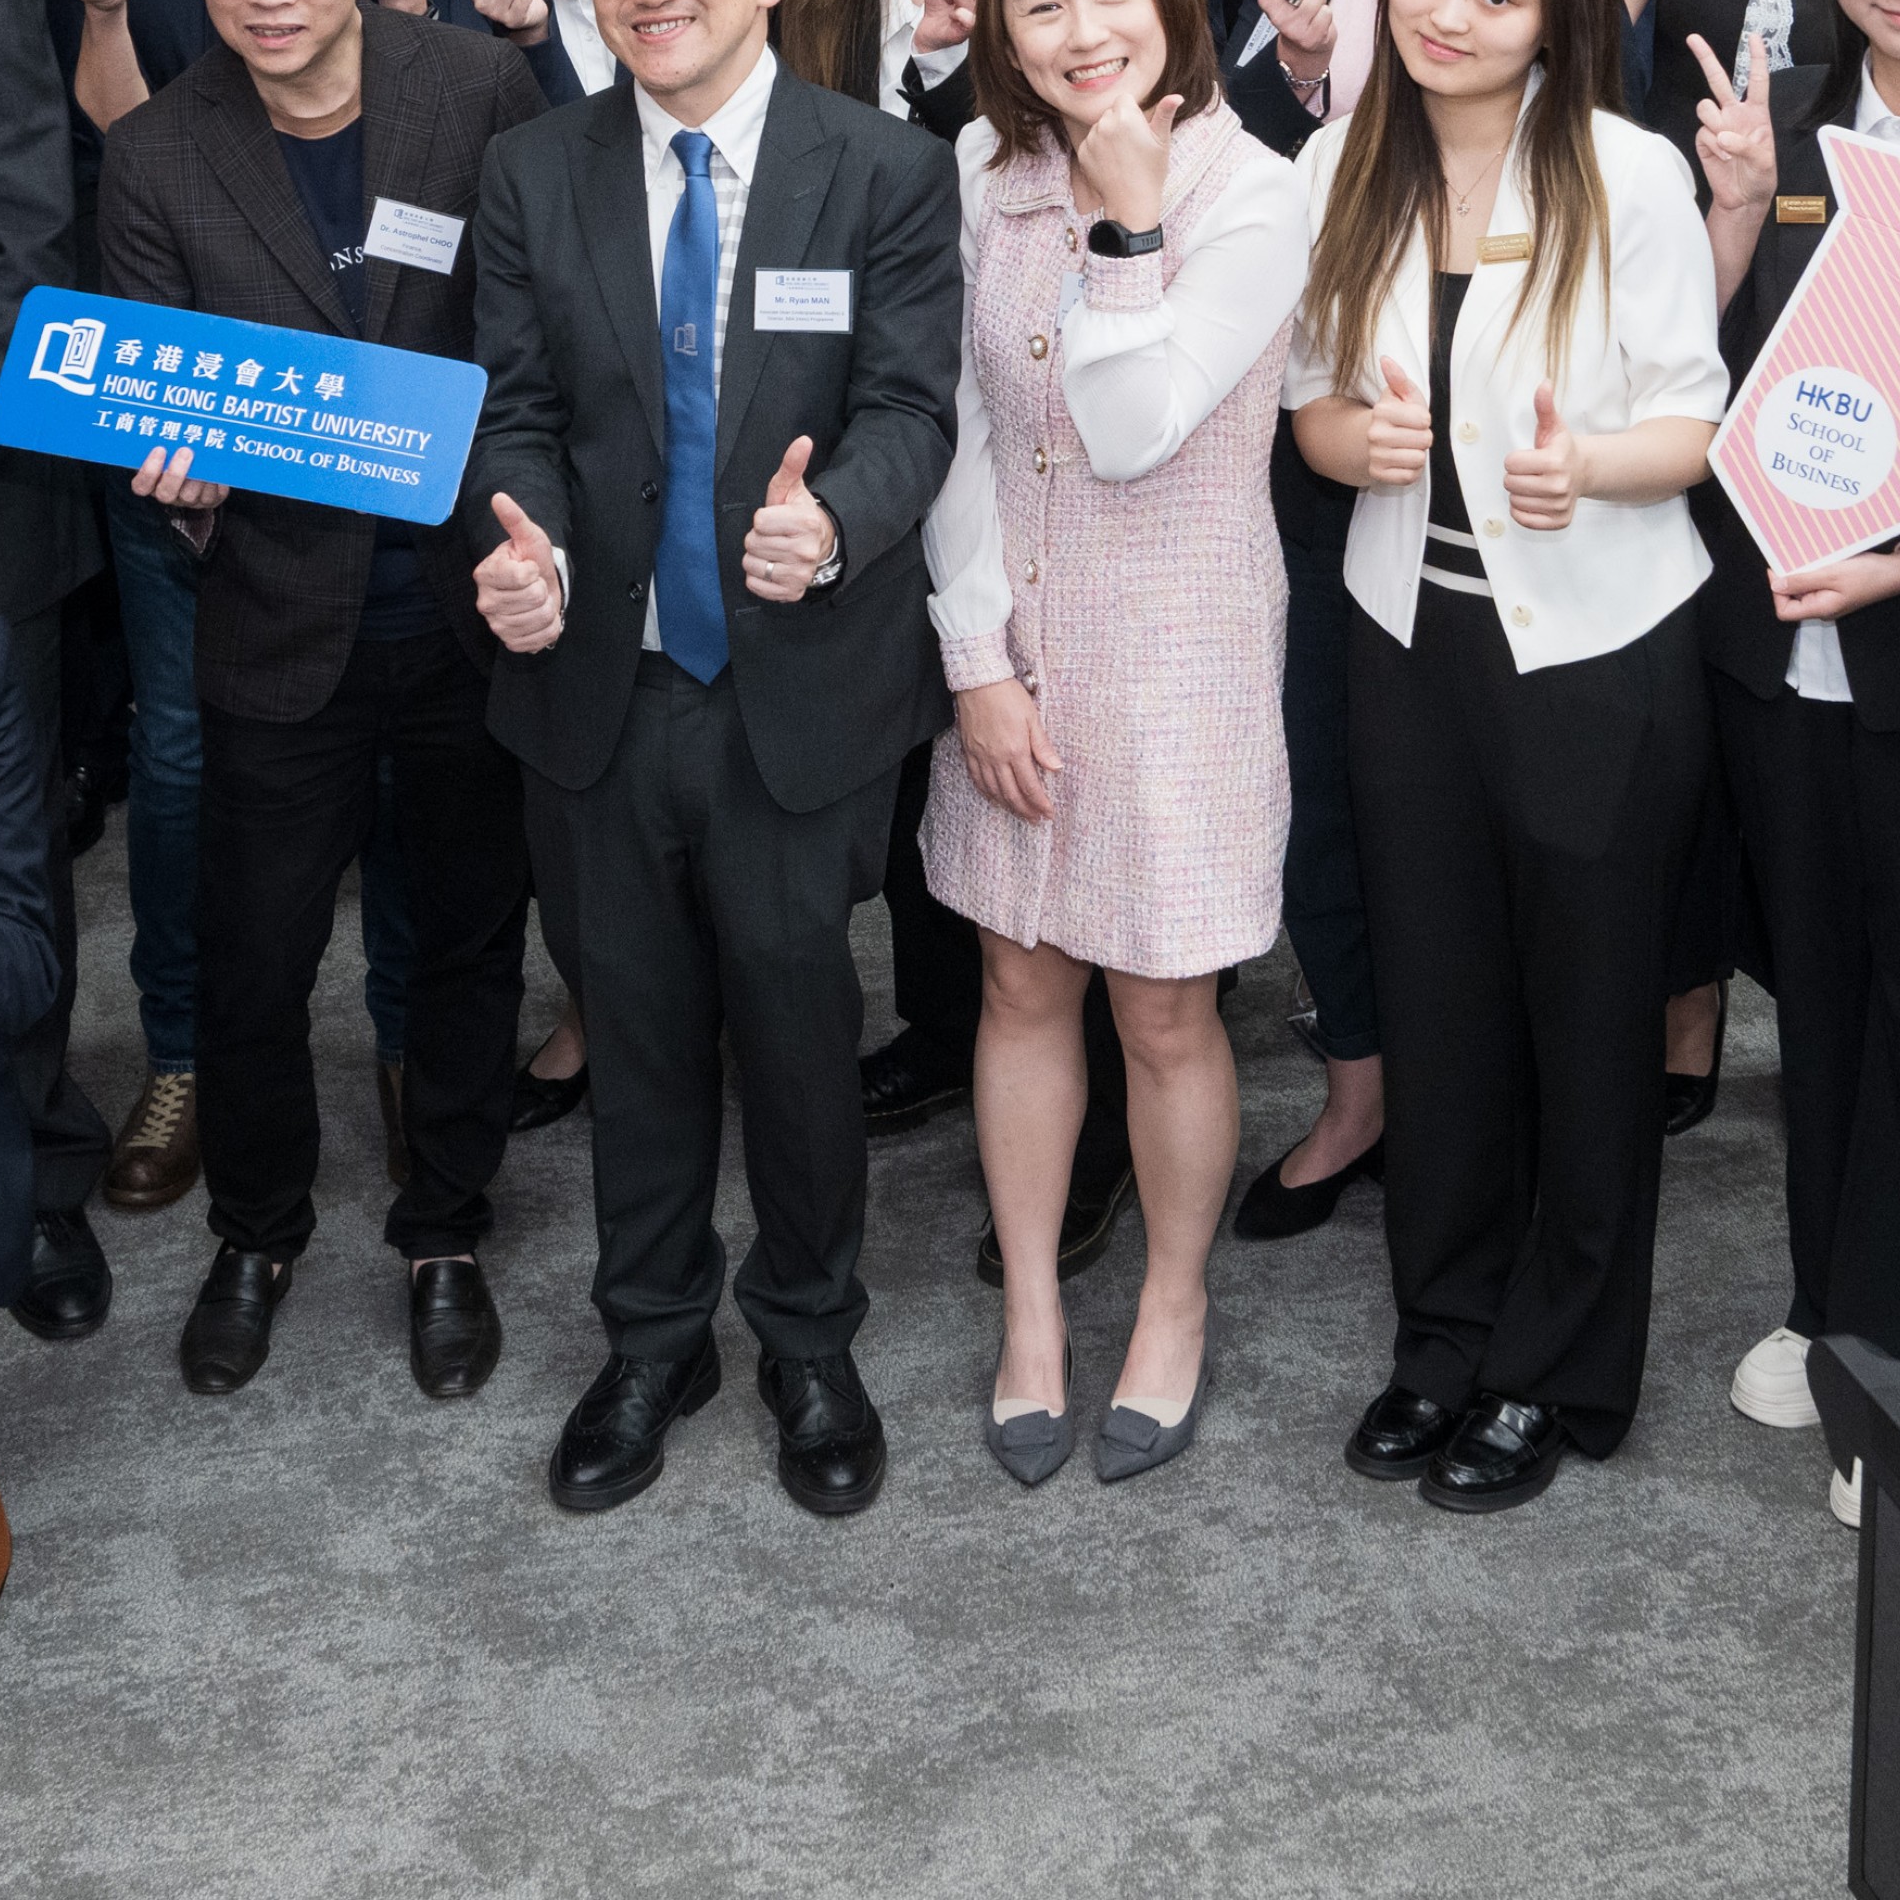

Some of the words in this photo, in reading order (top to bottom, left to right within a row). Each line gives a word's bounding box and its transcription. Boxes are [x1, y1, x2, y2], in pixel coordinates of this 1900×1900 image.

[811, 296, 830, 305] MAN
[113, 338, 347, 402] 香港浸會大學
[101, 372, 159, 401] HONG
[161, 383, 217, 412] KONG
[221, 395, 308, 428] BAPTIST
[311, 411, 433, 454] UNIVERSITY
[1795, 380, 1873, 423] HKBU
[91, 408, 227, 450] 工商管理學院
